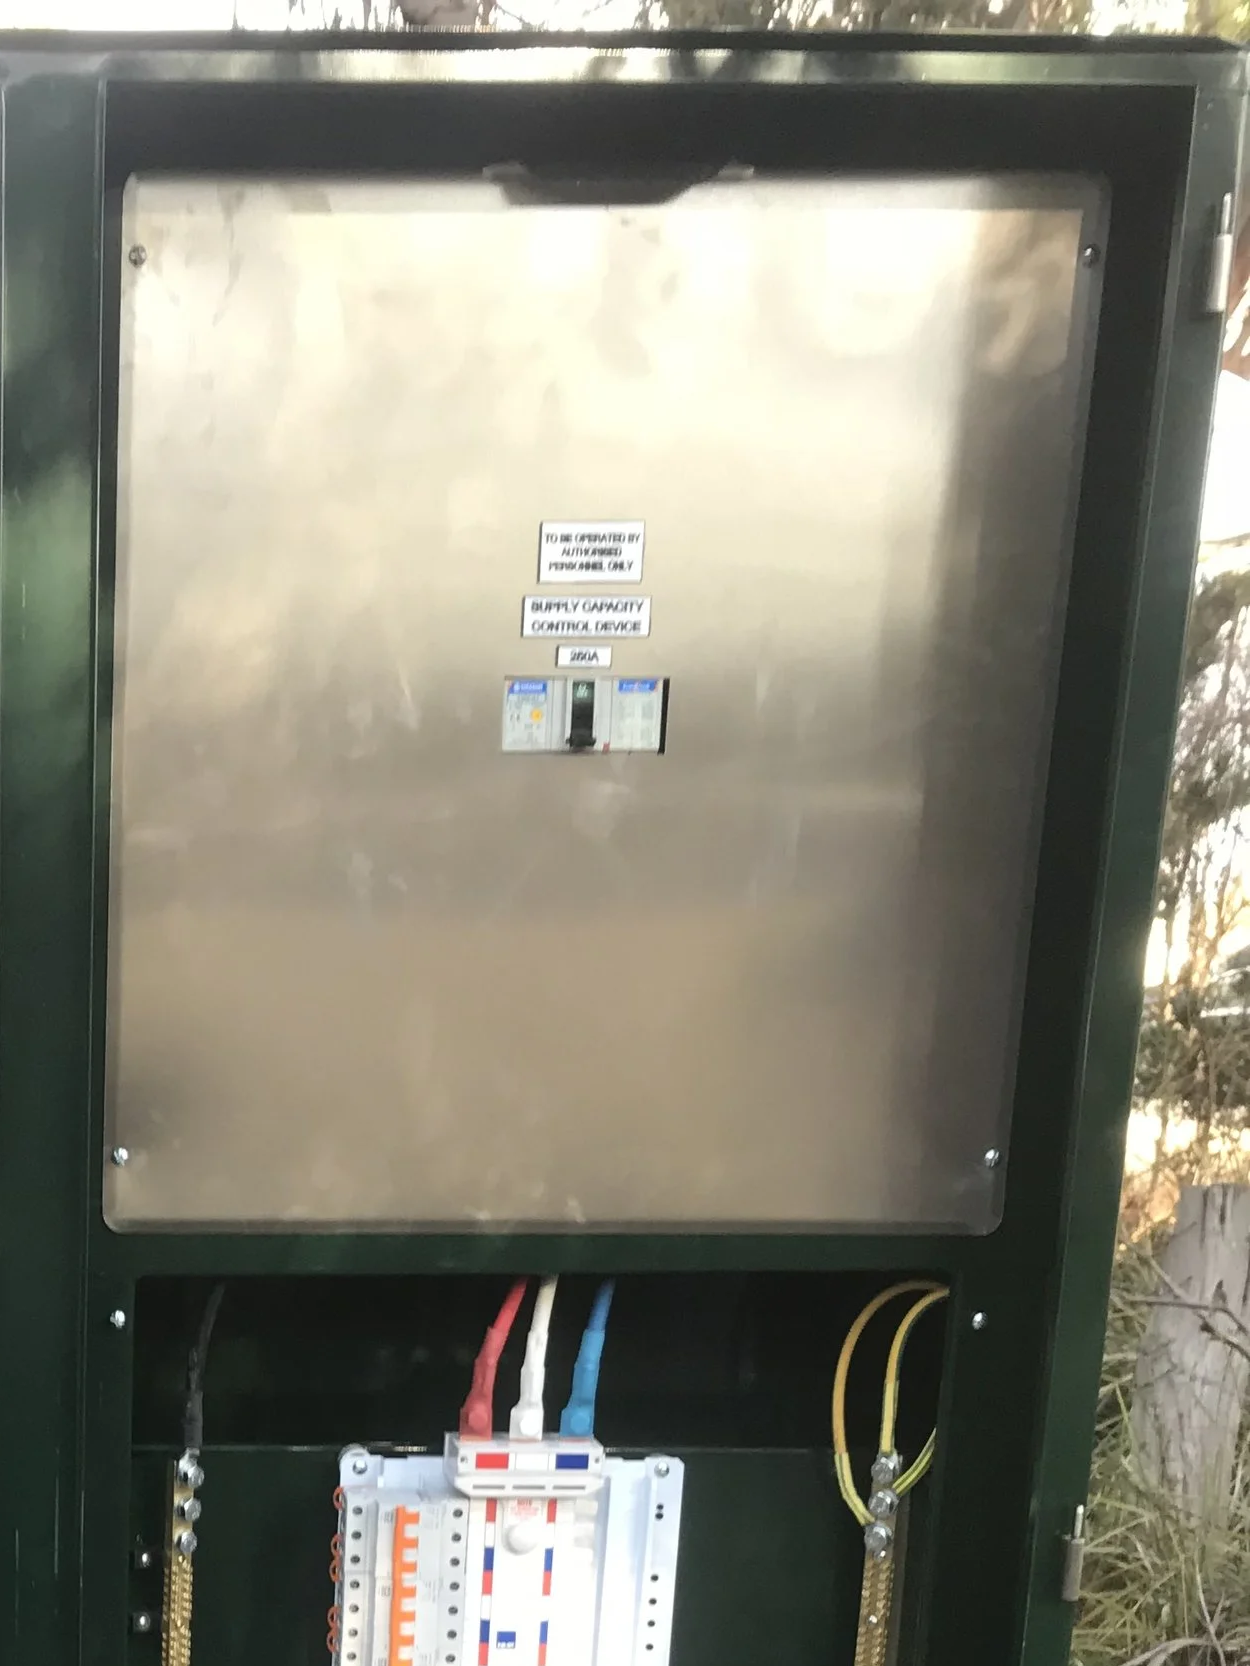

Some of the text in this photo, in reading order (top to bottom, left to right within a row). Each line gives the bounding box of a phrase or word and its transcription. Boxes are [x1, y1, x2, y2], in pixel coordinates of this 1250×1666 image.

[545, 533, 641, 544] TO BE OPERATED BY
[548, 561, 634, 572] PERSONNEL ONLY
[530, 600, 645, 613] SUPPLY CAPACITY
[531, 620, 642, 633] CONTROL DEVICE
